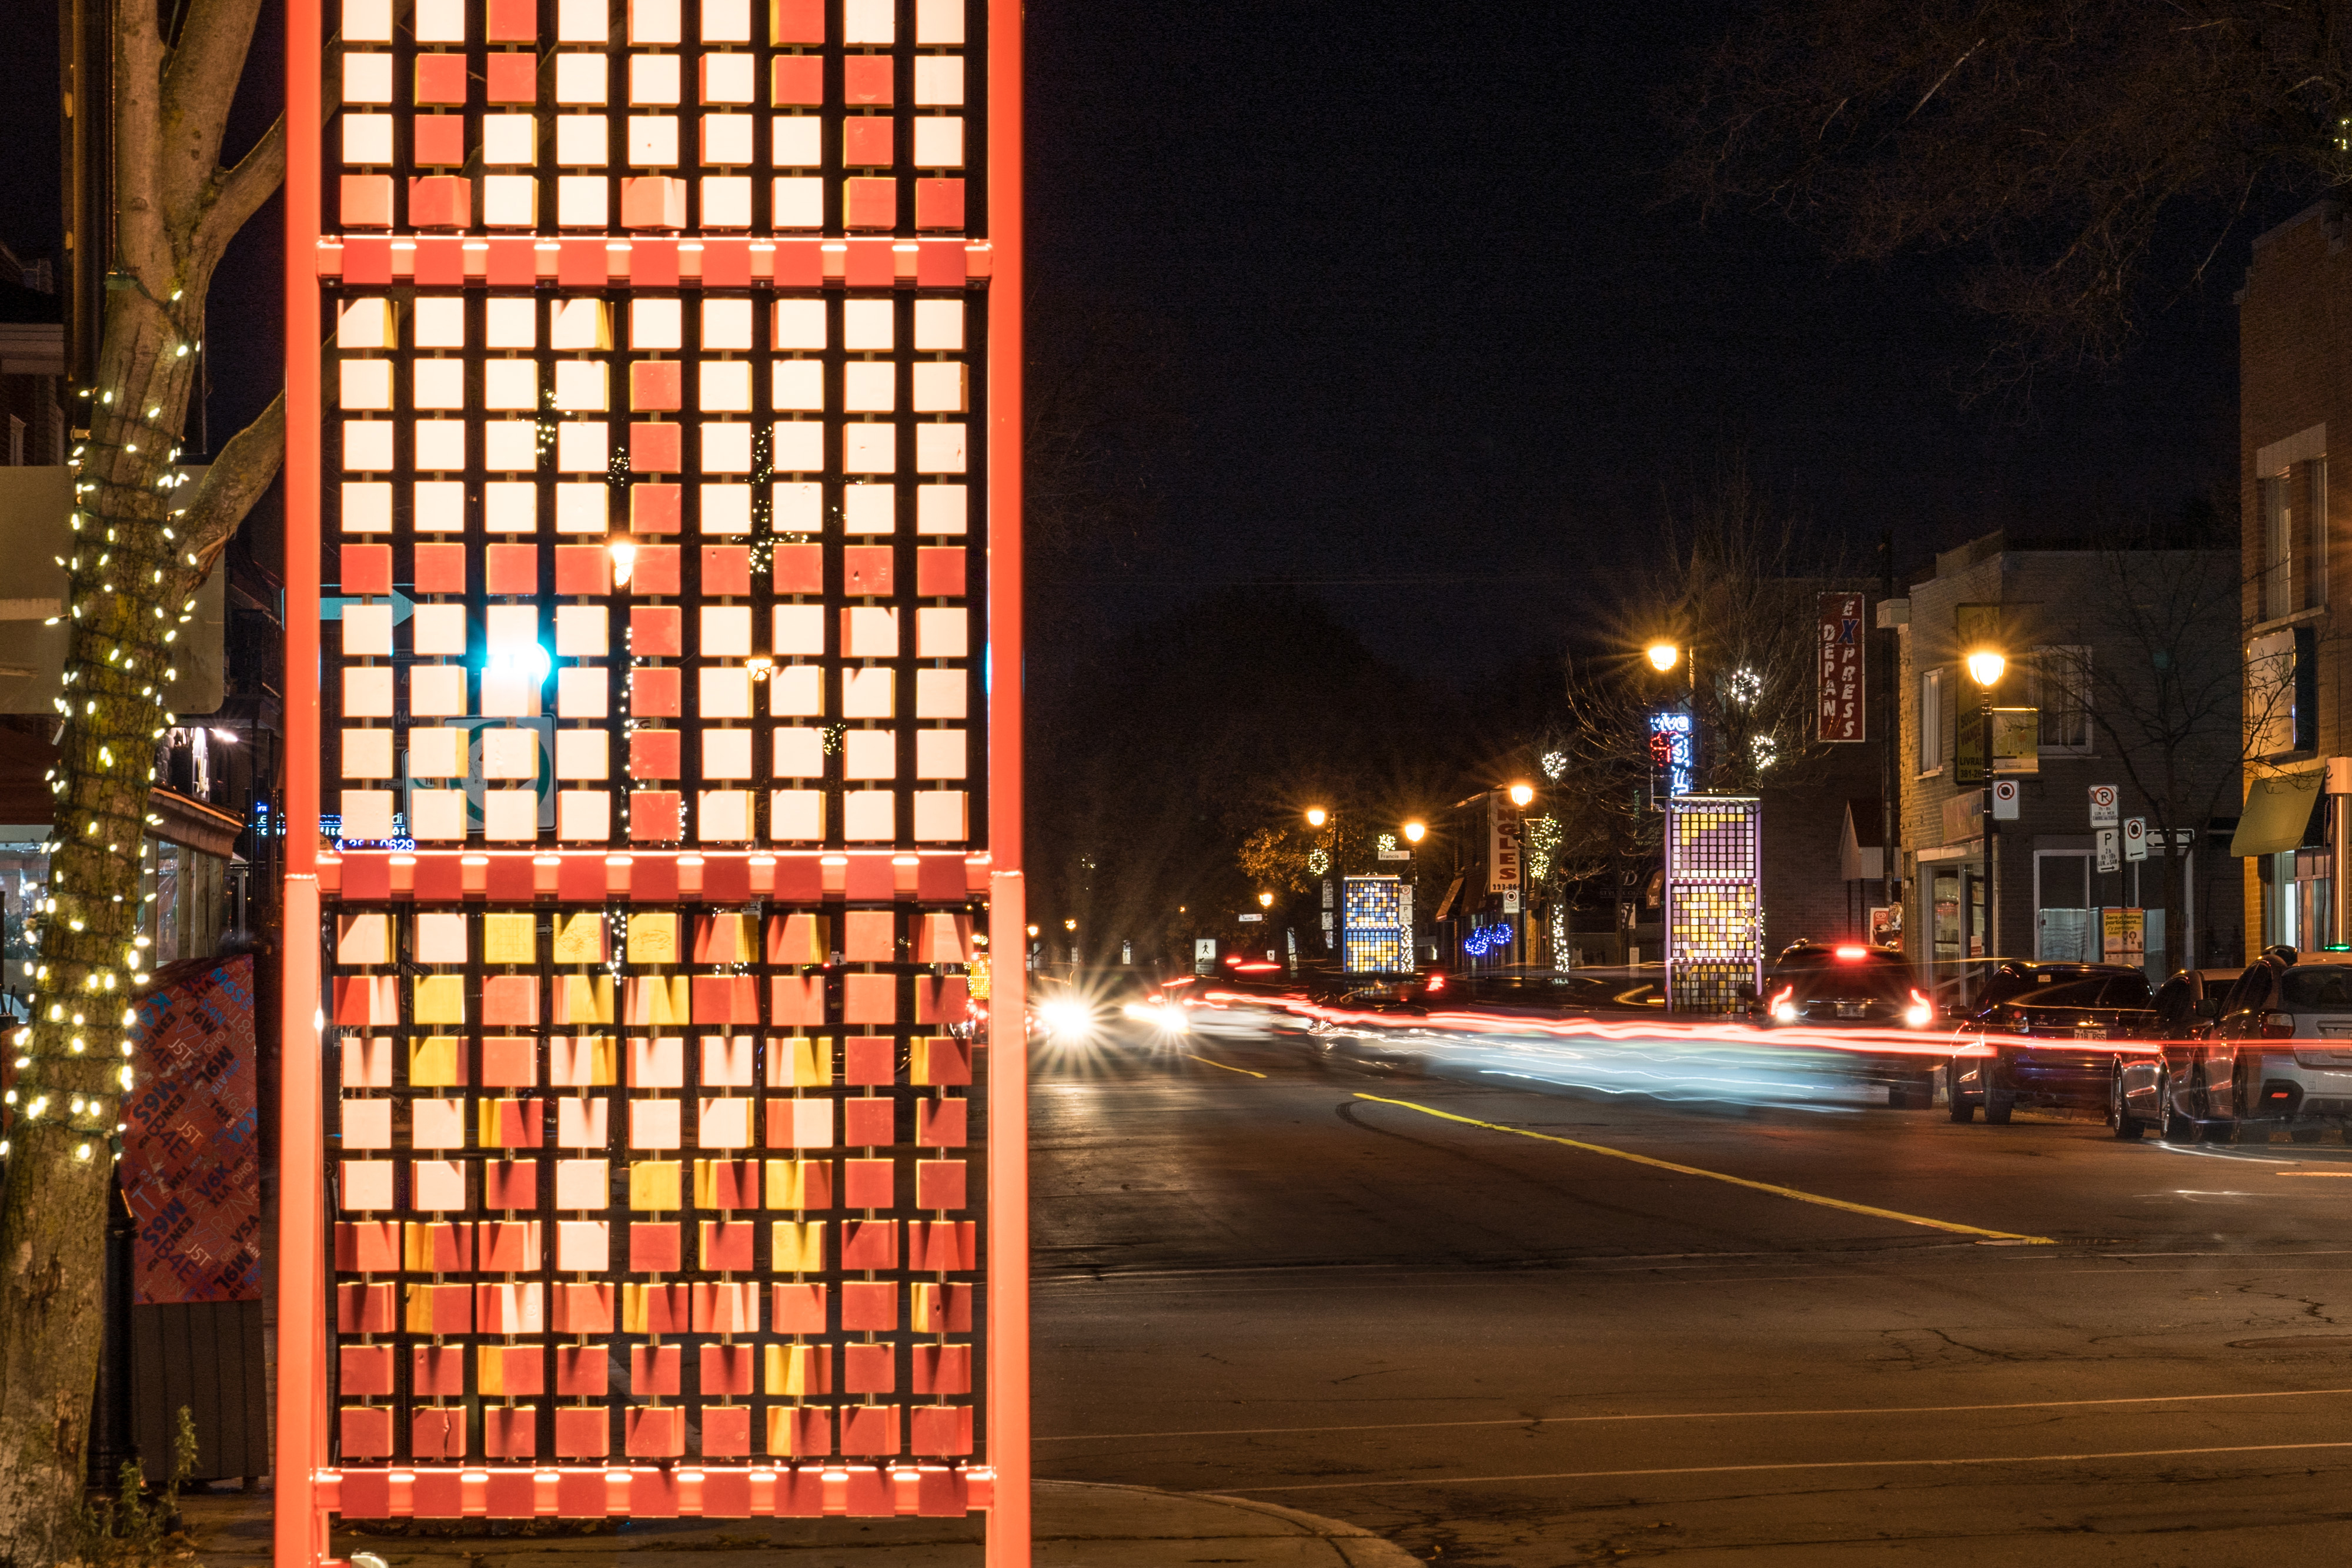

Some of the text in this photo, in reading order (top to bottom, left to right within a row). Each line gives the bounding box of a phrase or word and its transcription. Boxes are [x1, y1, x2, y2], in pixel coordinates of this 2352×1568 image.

[1823, 624, 1836, 717] DEPAN
[1836, 601, 1859, 737] EXPRESS
[2105, 833, 2112, 845] P
[211, 968, 245, 1002] M6S
[152, 1013, 176, 1036] E3N
[188, 1007, 216, 1035] J6W
[201, 999, 225, 1024] S4N
[141, 1037, 174, 1069] B4E
[169, 1038, 193, 1061] J5T
[196, 1048, 234, 1085] M9L
[133, 1078, 177, 1122] M6S
[161, 1095, 185, 1118] E3N
[148, 1118, 187, 1158] B4E
[178, 1120, 202, 1144] J5T
[196, 1163, 230, 1197] V6K
[141, 1201, 186, 1245] M6S
[170, 1217, 193, 1241] E3N
[211, 1192, 253, 1235] R7N
[156, 1239, 197, 1281] B4E
[186, 1243, 210, 1267] J5T
[246, 1243, 259, 1257] S4N
[213, 1252, 253, 1290] M9L
